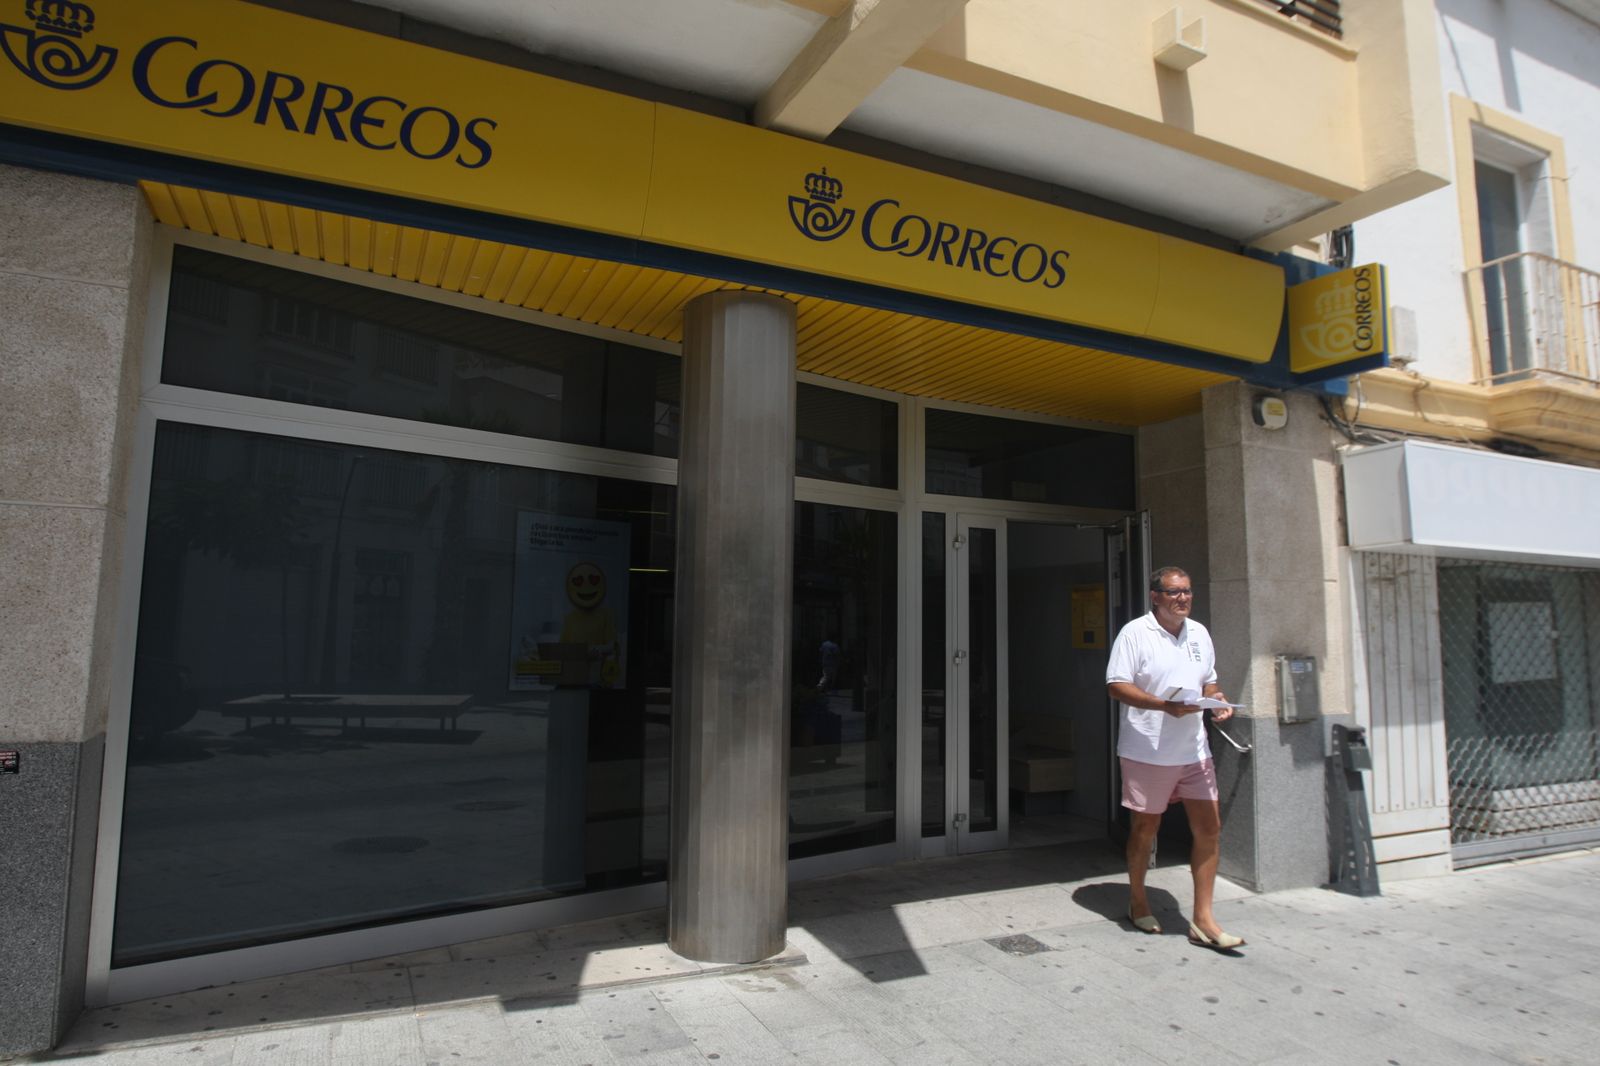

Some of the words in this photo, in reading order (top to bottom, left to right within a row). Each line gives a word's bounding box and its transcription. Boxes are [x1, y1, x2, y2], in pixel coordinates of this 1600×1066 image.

[132, 36, 498, 169] CORREOS
[861, 199, 1070, 289] CORREOS
[1353, 267, 1374, 352] CORREOS
